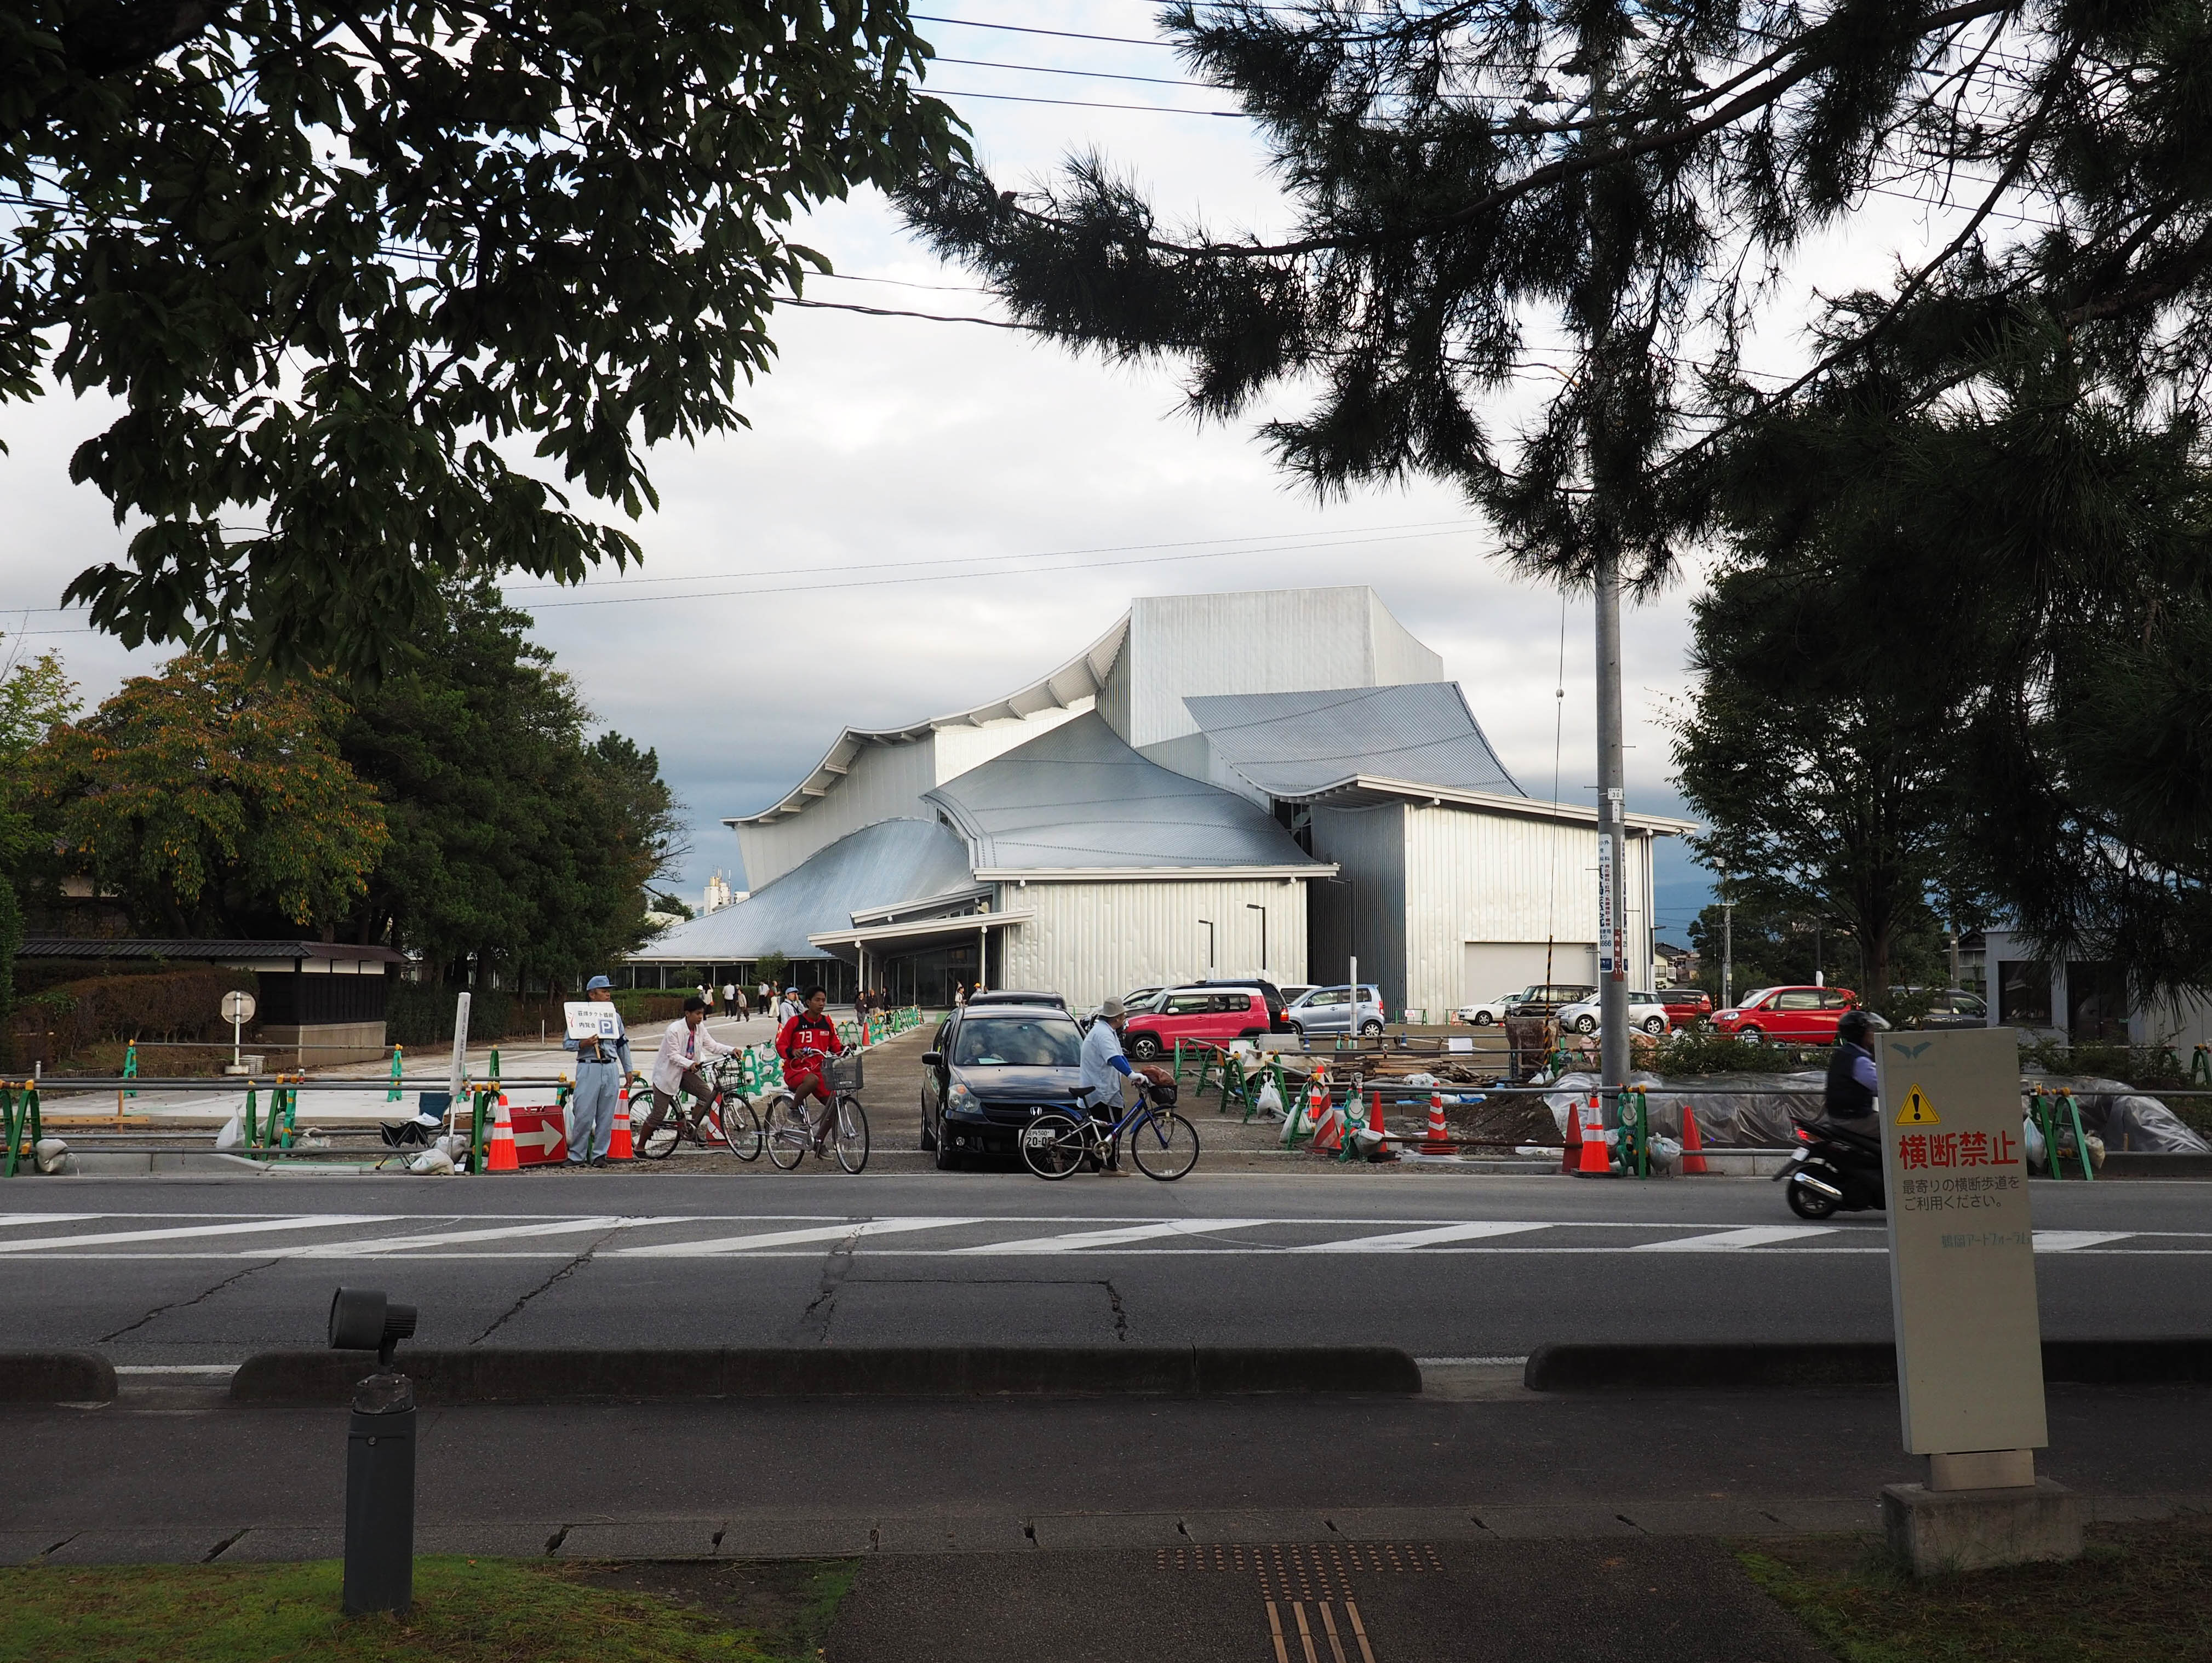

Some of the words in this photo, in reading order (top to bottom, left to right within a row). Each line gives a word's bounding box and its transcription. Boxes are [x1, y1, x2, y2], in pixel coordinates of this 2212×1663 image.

[601, 1021, 611, 1033] P
[799, 1031, 812, 1043] 73
[1027, 1137, 1052, 1146] 20-0
[1899, 1131, 2019, 1170] 横断禁止
[1902, 1176, 2020, 1194] 最寄りの横断歩道を
[1904, 1195, 2002, 1211] ご利用ください。
